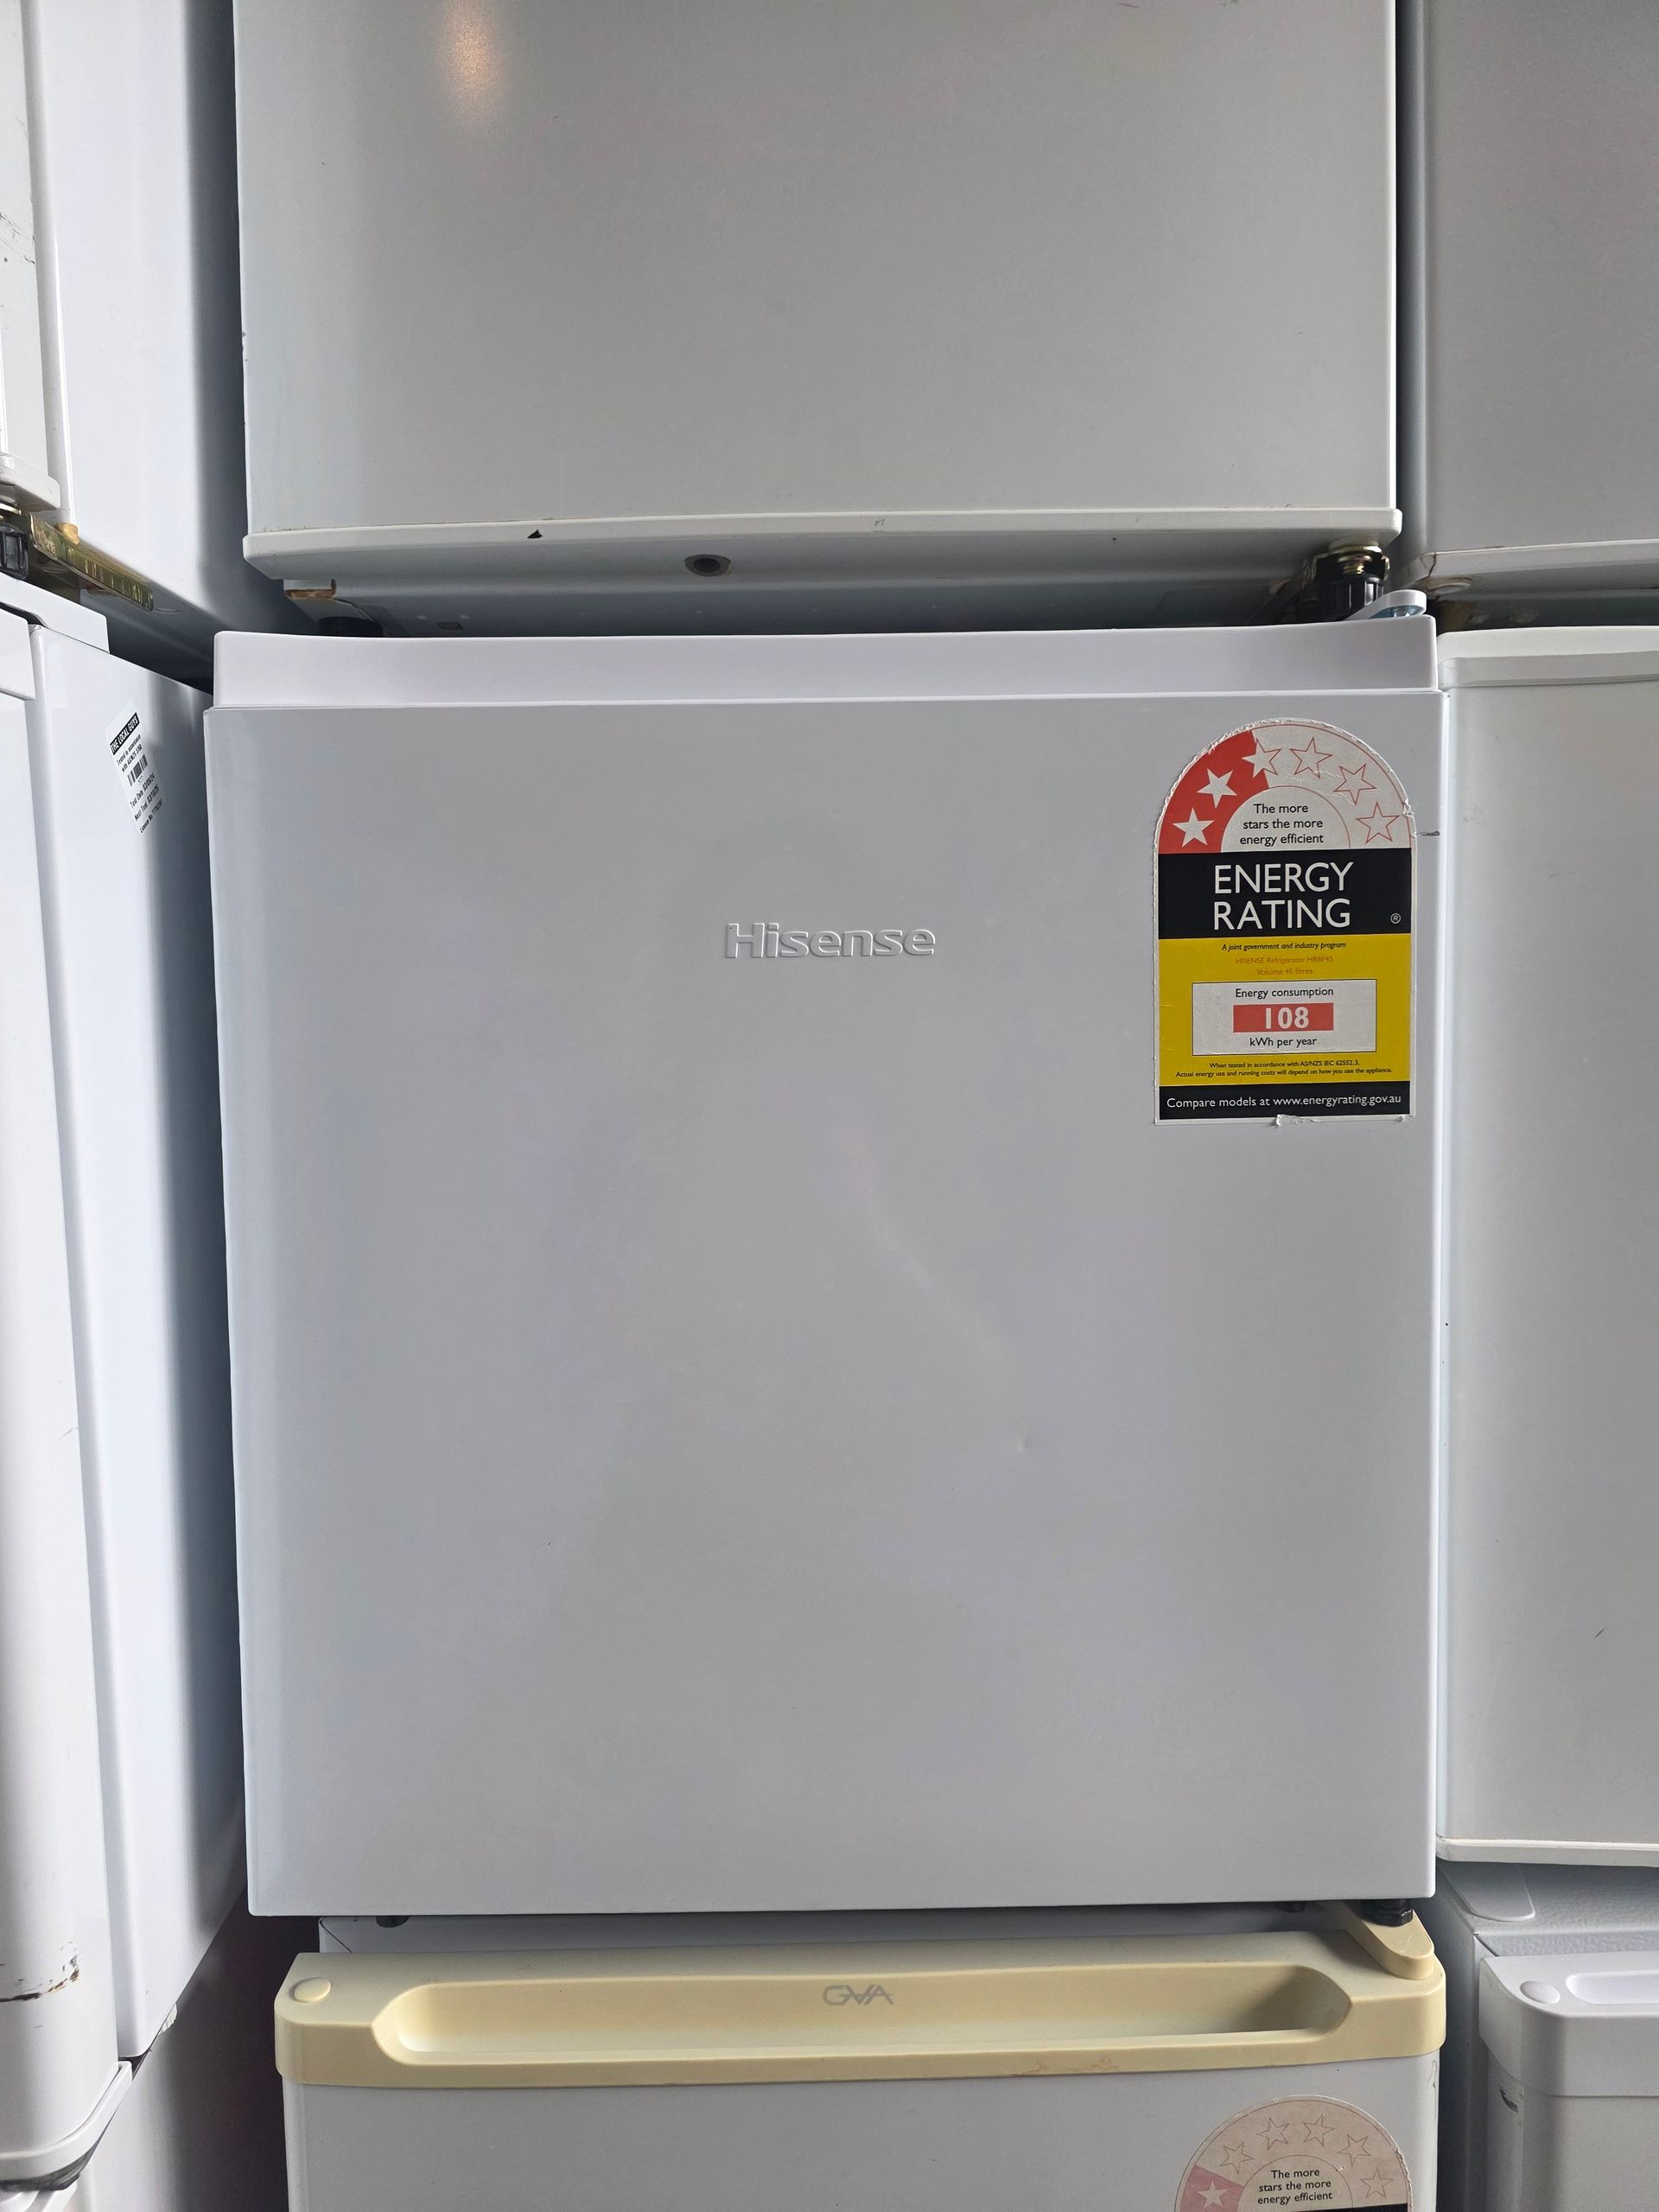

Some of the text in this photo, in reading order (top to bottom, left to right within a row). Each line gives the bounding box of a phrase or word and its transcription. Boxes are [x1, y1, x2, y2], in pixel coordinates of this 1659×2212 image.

[110, 715, 139, 755] THE LOCAL GUYS
[1254, 804, 1308, 814] The more
[1243, 818, 1324, 830] stars the more
[1239, 833, 1324, 848] energy efficient
[1214, 861, 1354, 894] ENERGY
[1213, 899, 1351, 931] RATING
[725, 922, 936, 958] Hisense
[1228, 944, 1242, 952] joint
[1295, 942, 1319, 950] industry
[1320, 942, 1346, 950] program
[1267, 957, 1305, 965] Refrigerator
[1235, 987, 1334, 1000] Energy consumption
[1264, 1007, 1310, 1030] 108
[1249, 1037, 1318, 1049] kWh per year
[1287, 1068, 1308, 1077] depend
[1166, 1094, 1402, 1109] Compare models at www.energyrating.gov.au
[1271, 2170, 1320, 2180] The more
[1258, 2180, 1332, 2192] stars the more
[1257, 2192, 1332, 2205] energy efficient
